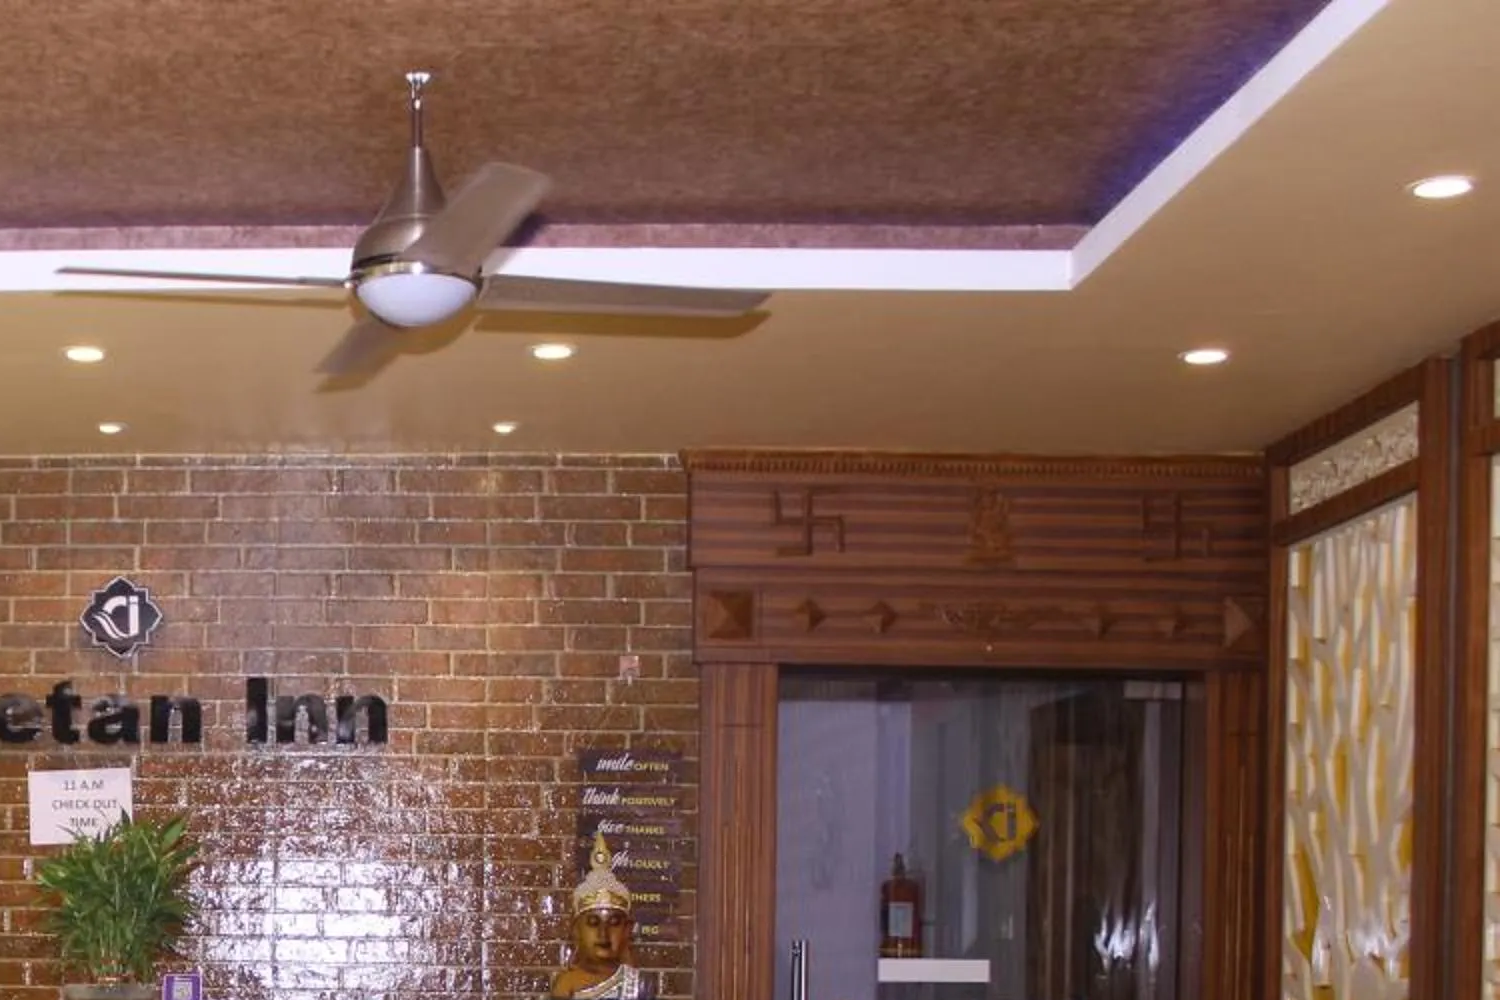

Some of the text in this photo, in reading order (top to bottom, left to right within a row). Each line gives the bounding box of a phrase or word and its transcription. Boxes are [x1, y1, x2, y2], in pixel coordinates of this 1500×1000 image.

[246, 677, 388, 745] Inn
[63, 780, 77, 791] 11
[52, 799, 117, 811] CHECK OUT
[69, 817, 99, 828] TIME
